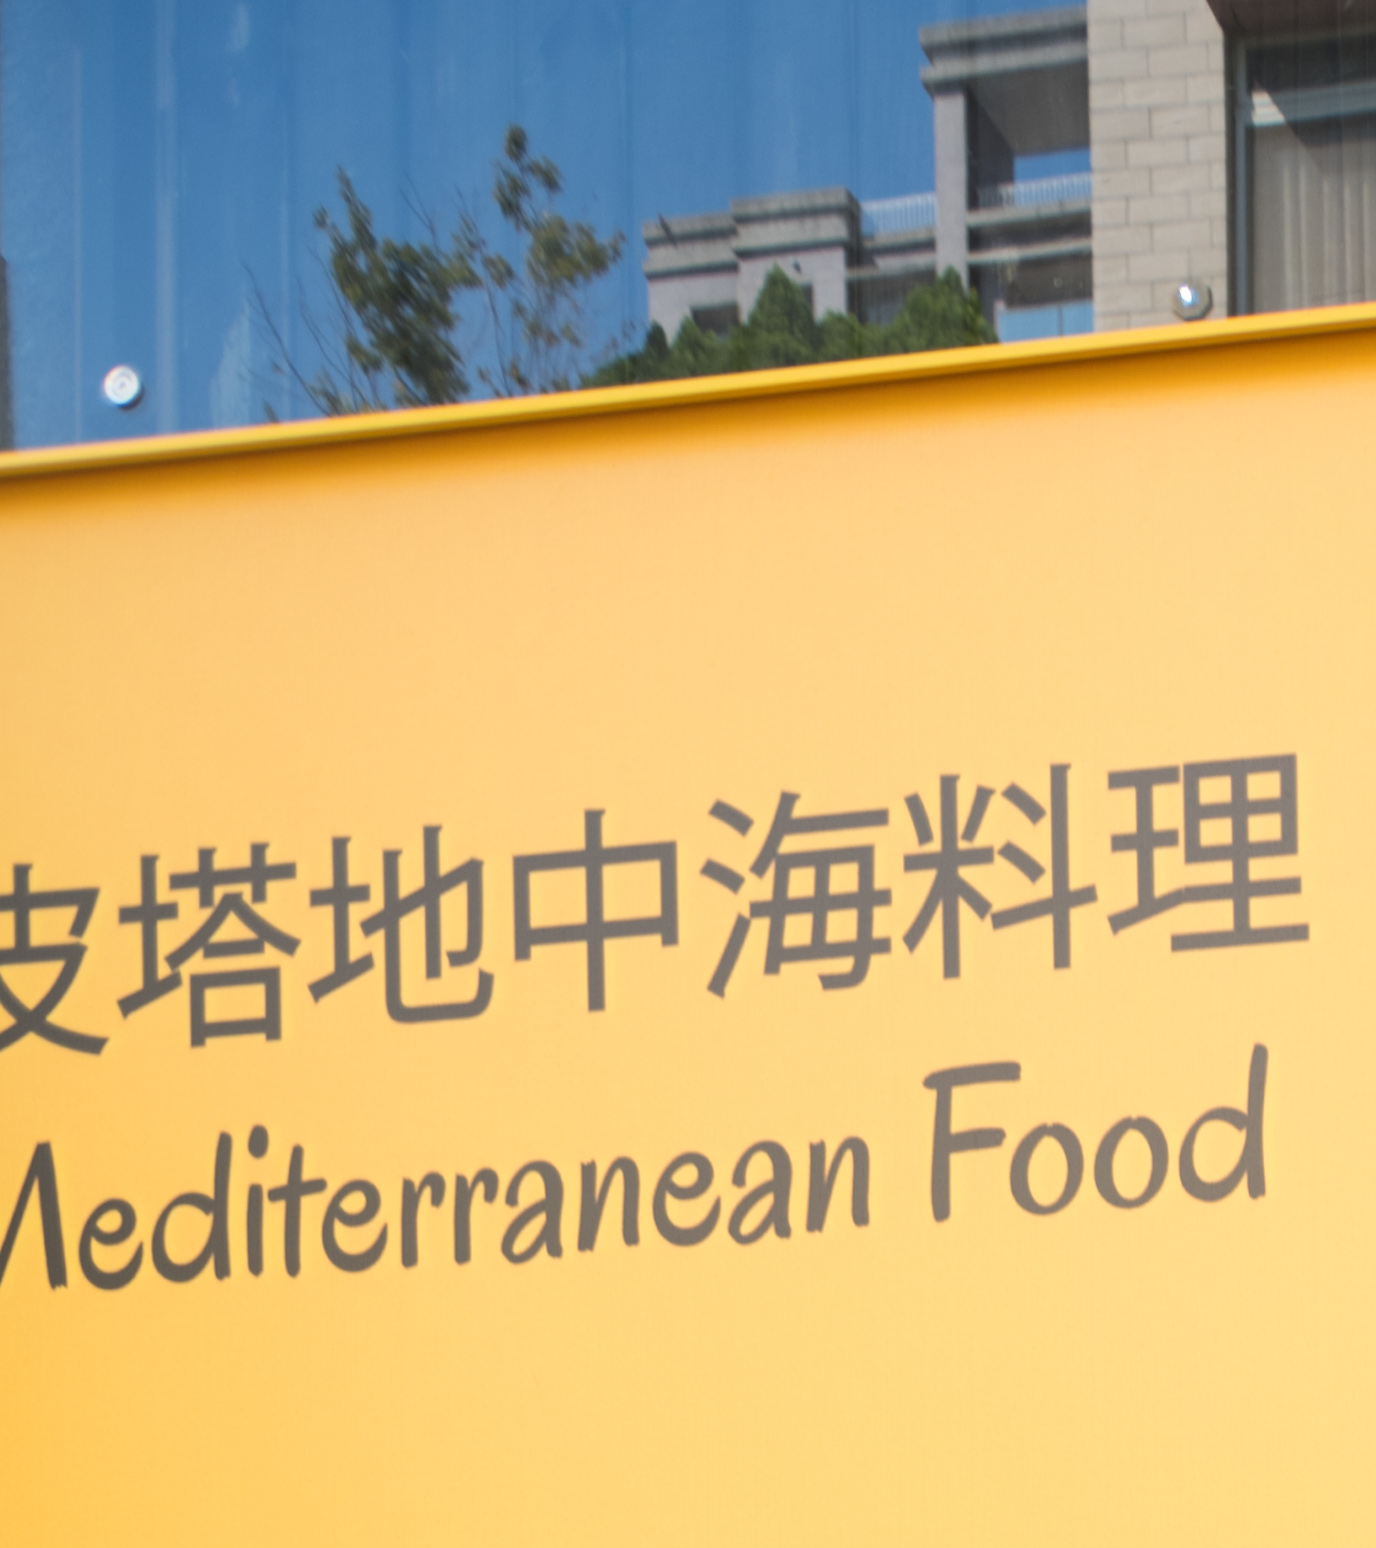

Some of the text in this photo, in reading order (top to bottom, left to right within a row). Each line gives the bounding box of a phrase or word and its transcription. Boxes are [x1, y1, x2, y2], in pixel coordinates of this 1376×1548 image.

[0, 754, 1309, 1056] 皮塔地中海料理
[923, 1044, 1268, 1222] Food
